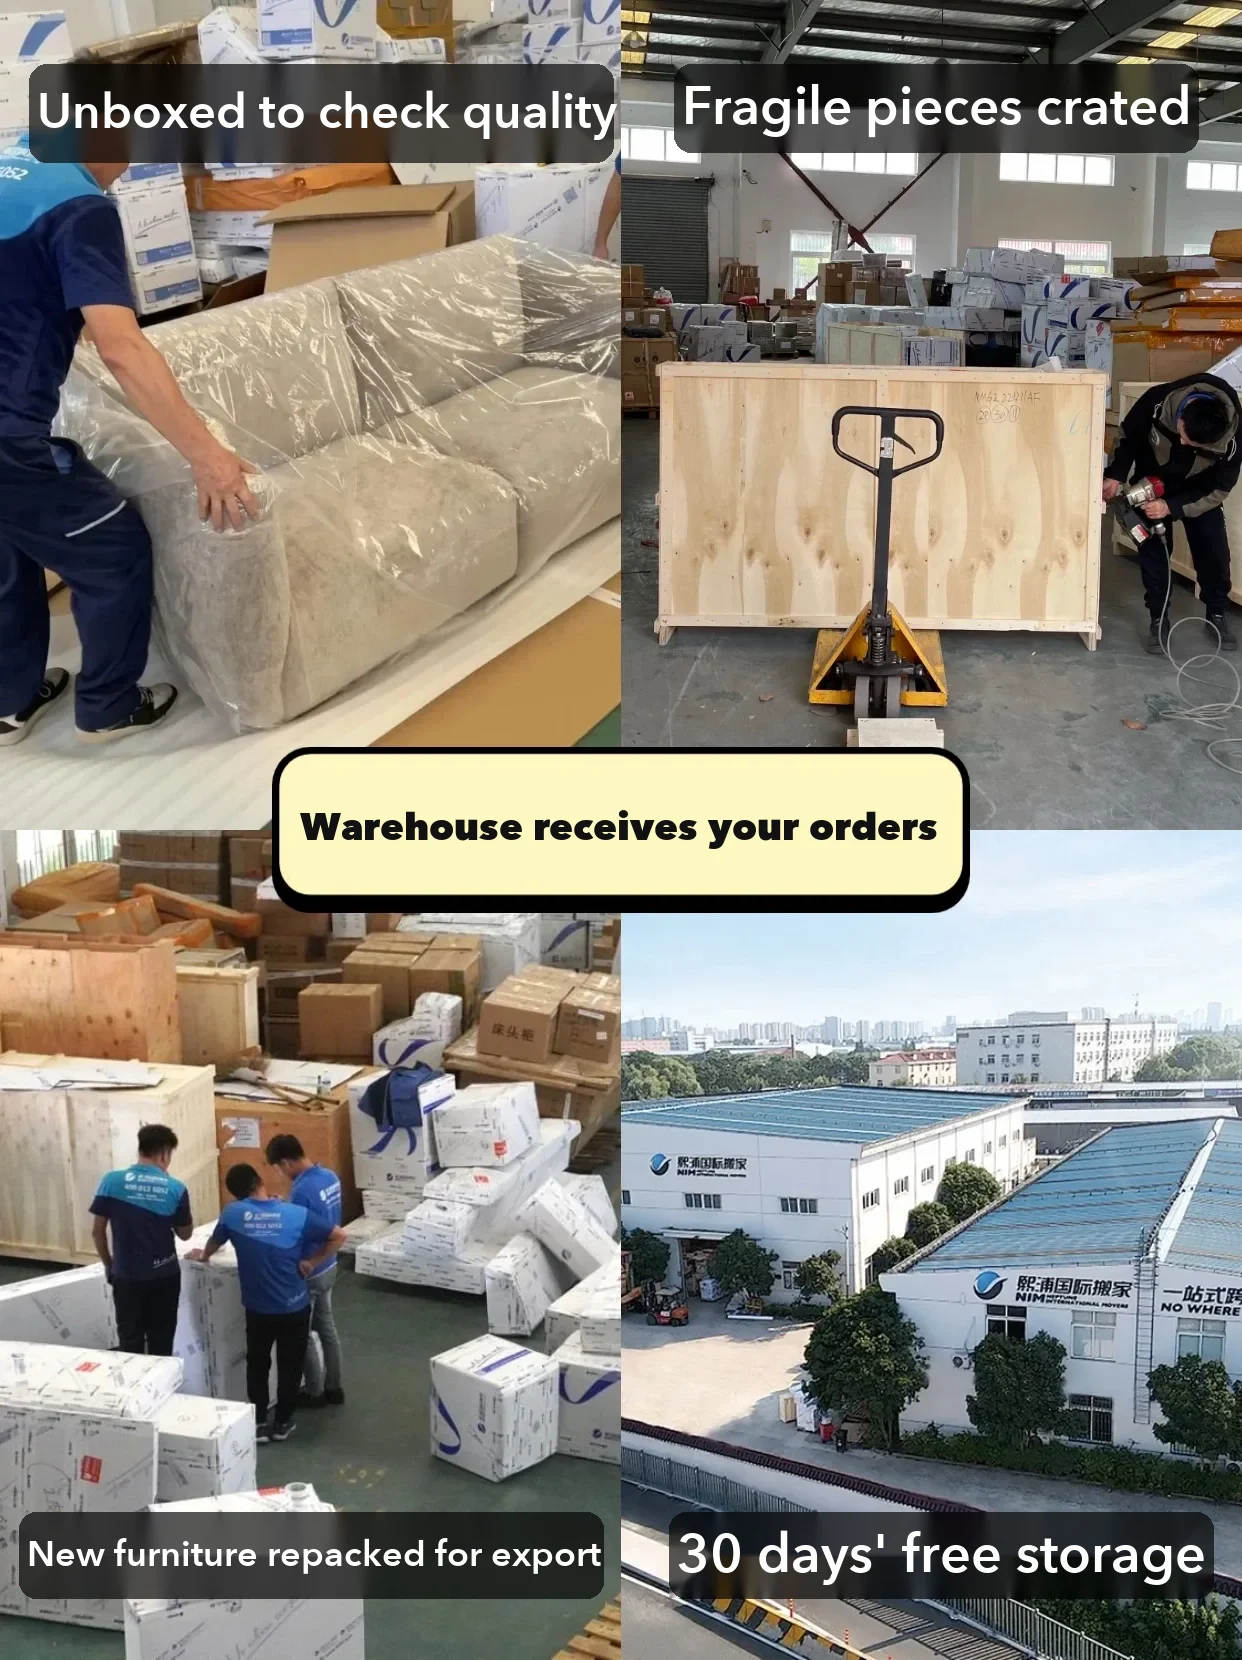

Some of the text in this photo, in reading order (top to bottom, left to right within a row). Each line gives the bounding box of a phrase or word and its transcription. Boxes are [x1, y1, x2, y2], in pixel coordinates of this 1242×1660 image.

[490, 1021, 536, 1043] 床头柜
[677, 1168, 697, 1176] NIM
[1016, 1275, 1133, 1298] 熙浦国际搬家
[1015, 1292, 1046, 1304] NIM
[1161, 1302, 1241, 1317] NO WHERE
